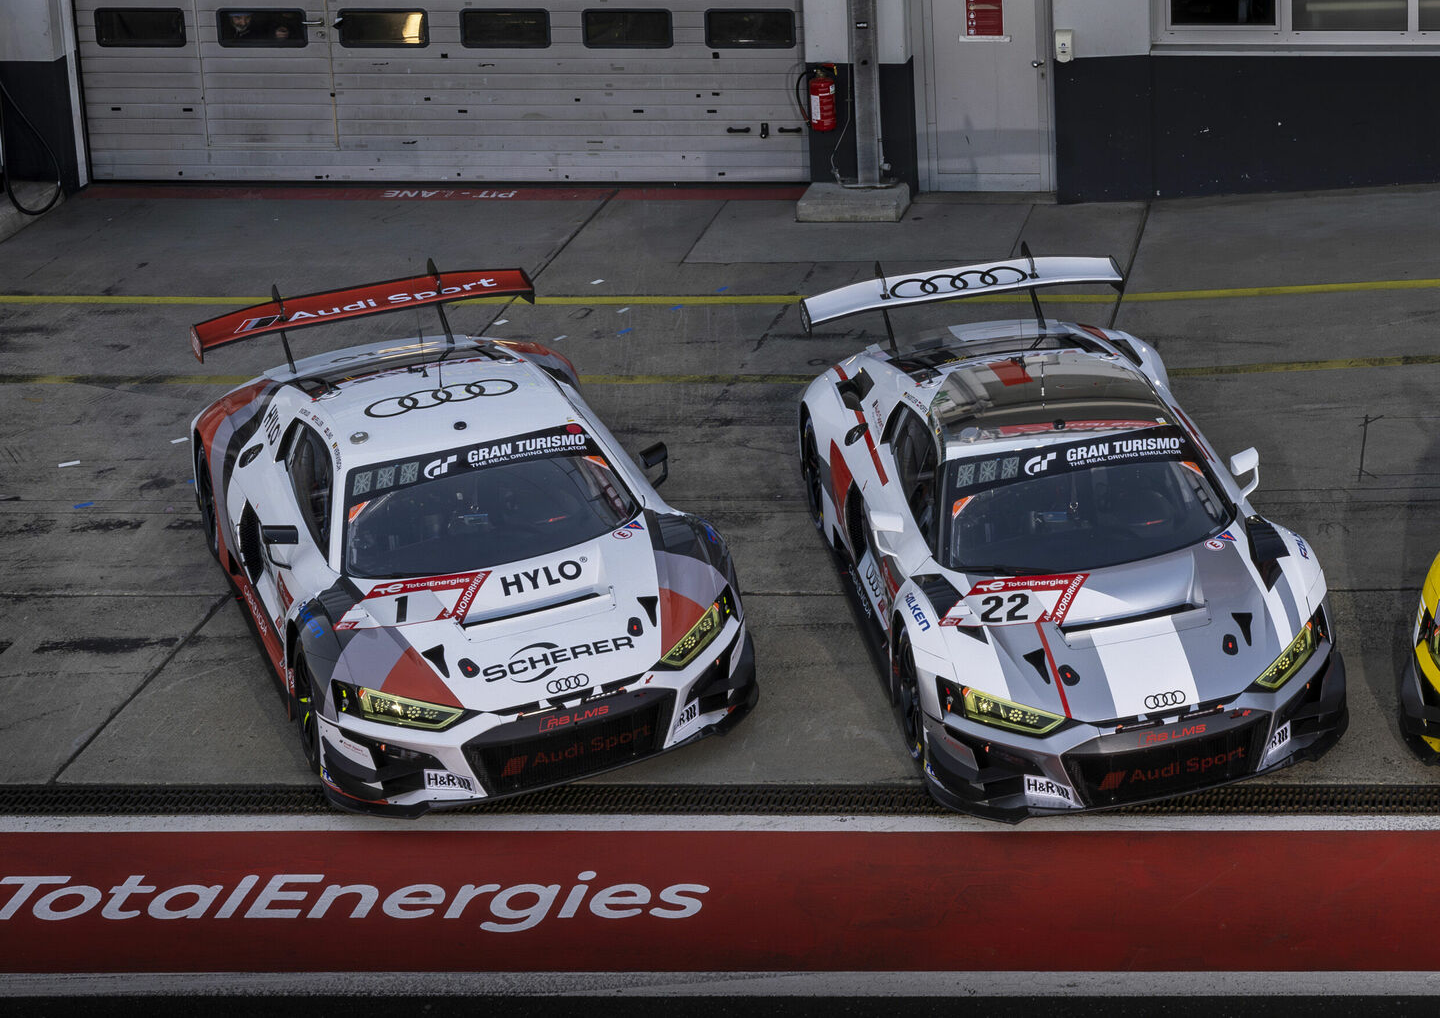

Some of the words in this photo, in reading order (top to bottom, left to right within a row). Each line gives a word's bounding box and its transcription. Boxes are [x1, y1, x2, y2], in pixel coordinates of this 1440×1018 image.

[288, 297, 378, 322] Audi
[387, 278, 497, 304] Sport
[468, 443, 512, 463] GRAN
[516, 434, 585, 451] TURISMO
[470, 460, 487, 468] THE
[488, 456, 509, 464] REAL
[511, 450, 542, 459] DRIVING
[544, 446, 587, 454] SIMULATOR
[1066, 443, 1109, 462] GRAN
[1113, 438, 1179, 453] TURISMO
[1108, 452, 1138, 460] DRIVING
[406, 577, 470, 589] TotalEnergies
[500, 560, 583, 596] HYLO
[1007, 578, 1068, 588] TotalEnergies
[456, 572, 485, 617] NORDRHEIN
[980, 594, 1029, 622] 22
[1055, 574, 1084, 617] NORDRHEIN
[394, 596, 408, 623] 1
[905, 592, 930, 632] FALKEN
[482, 636, 634, 683] SCHERER
[574, 706, 609, 722] LMS
[532, 743, 584, 767] Audi
[592, 725, 650, 752] Sport
[1130, 762, 1180, 782] Audi
[1187, 746, 1245, 773] Sport
[427, 773, 457, 787] H&R
[1027, 779, 1055, 793] H&R
[0, 871, 710, 933] TotalEnergies
